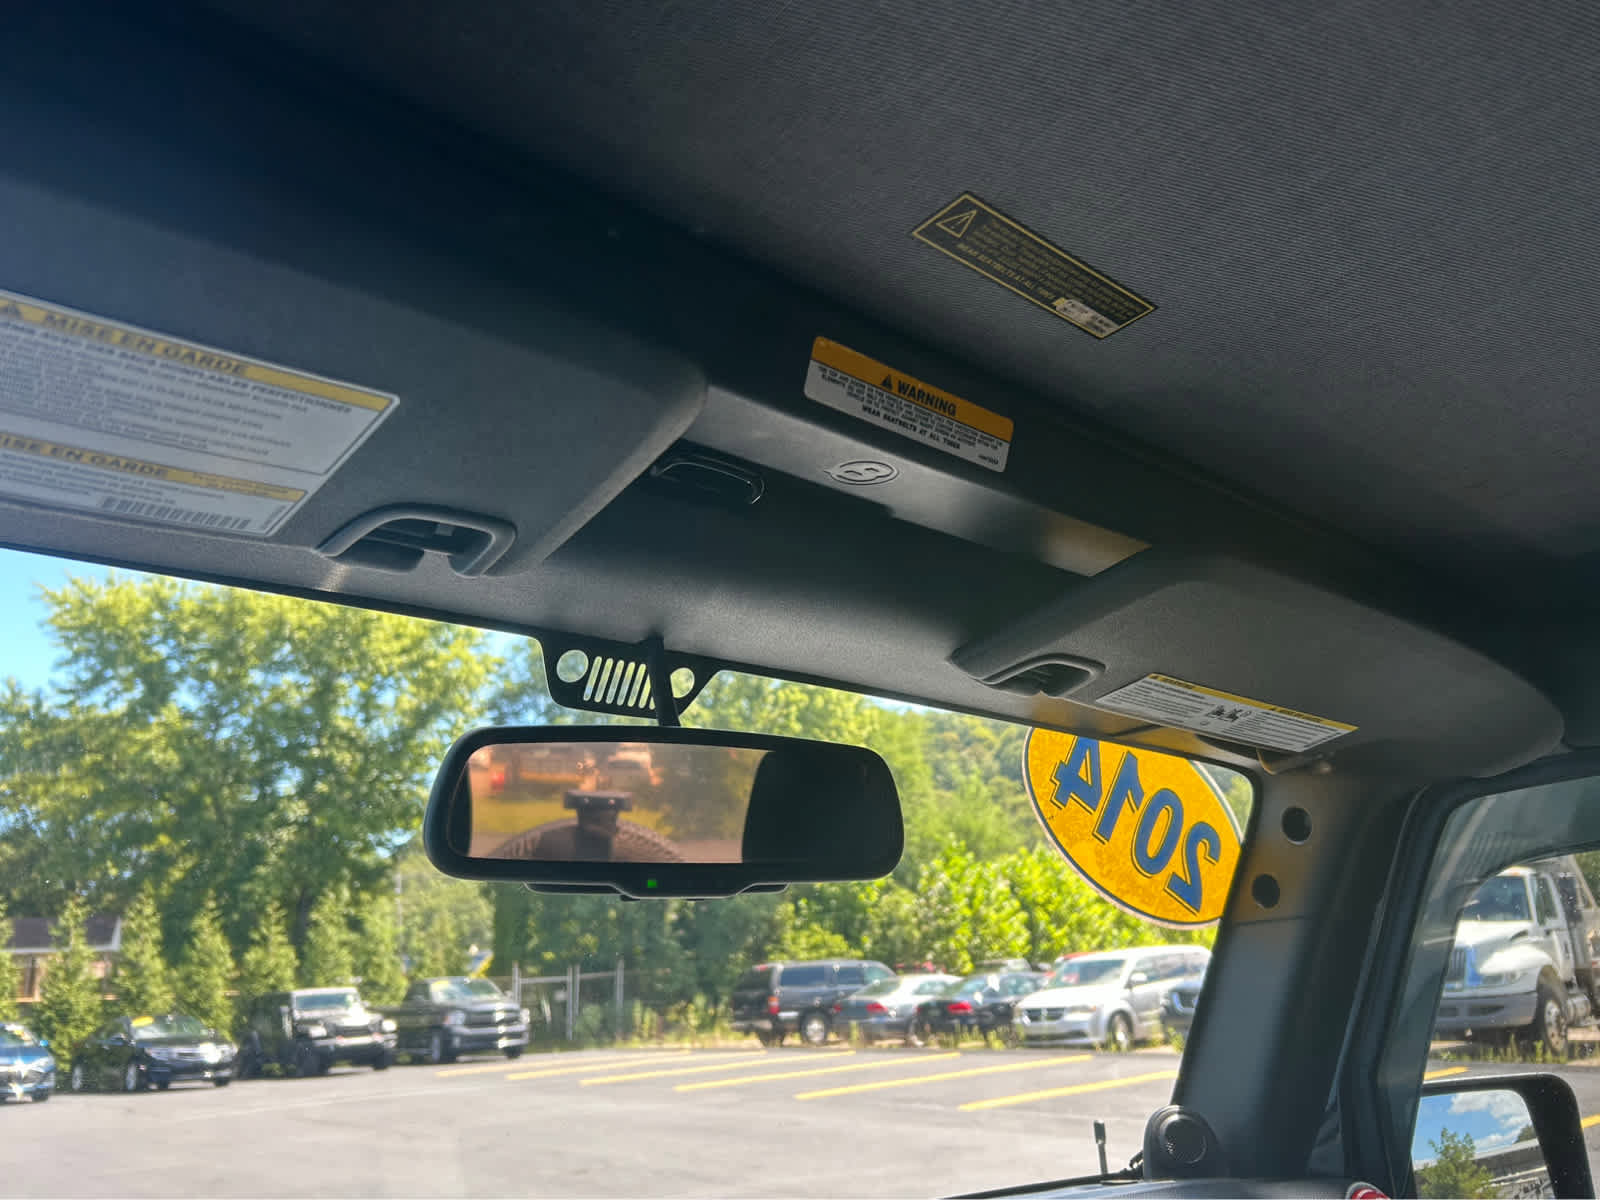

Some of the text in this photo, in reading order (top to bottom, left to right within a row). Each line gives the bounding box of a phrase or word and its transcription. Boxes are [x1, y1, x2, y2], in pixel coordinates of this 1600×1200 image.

[44, 313, 246, 376] MISE EN GARDE
[862, 405, 881, 417] WEAR
[898, 379, 957, 416] WARNING
[0, 434, 39, 452] ISE
[90, 455, 164, 476] GARDE
